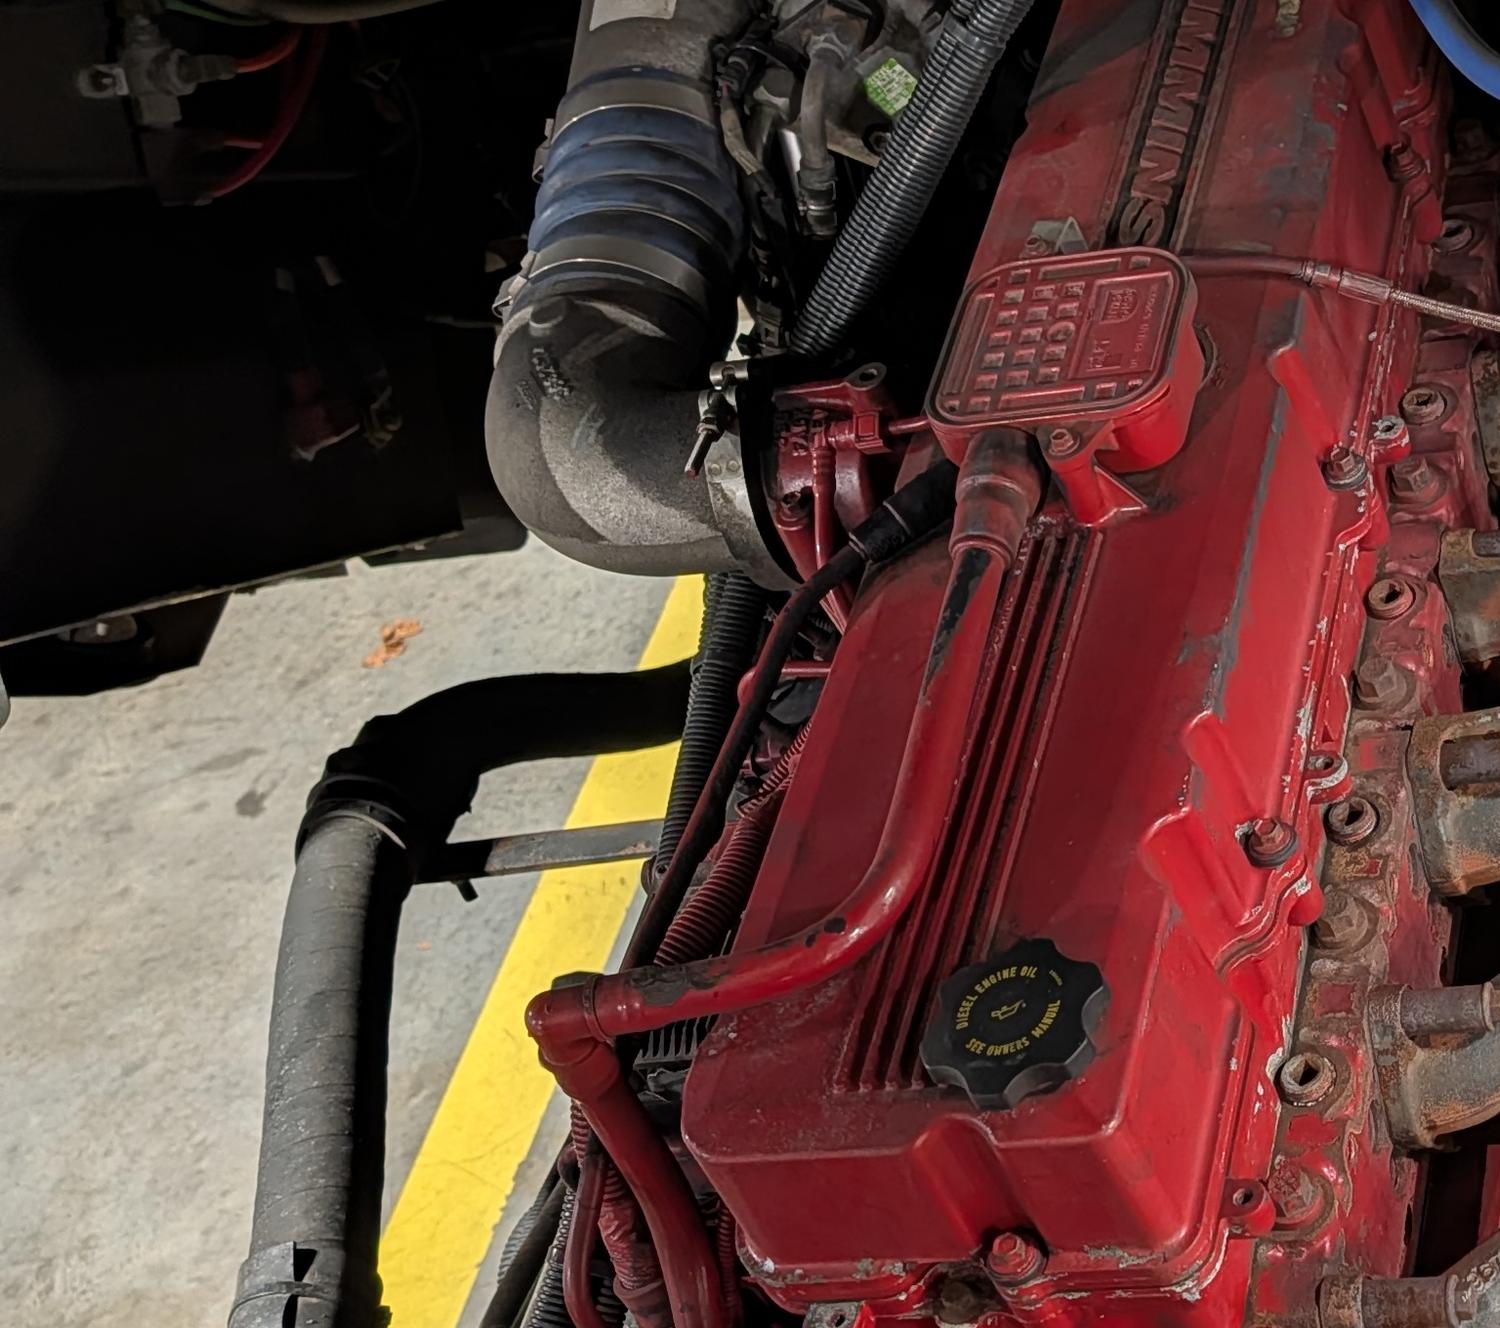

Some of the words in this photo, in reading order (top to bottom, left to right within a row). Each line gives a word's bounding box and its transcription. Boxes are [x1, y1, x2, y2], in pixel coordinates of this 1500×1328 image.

[956, 992, 979, 1031] DIESEL
[974, 965, 1019, 995] ENGINE
[1019, 965, 1040, 979] OIL
[965, 1037, 987, 1056] SEE
[986, 1036, 1031, 1057] OWNERS
[1031, 999, 1062, 1039] MANUAL
